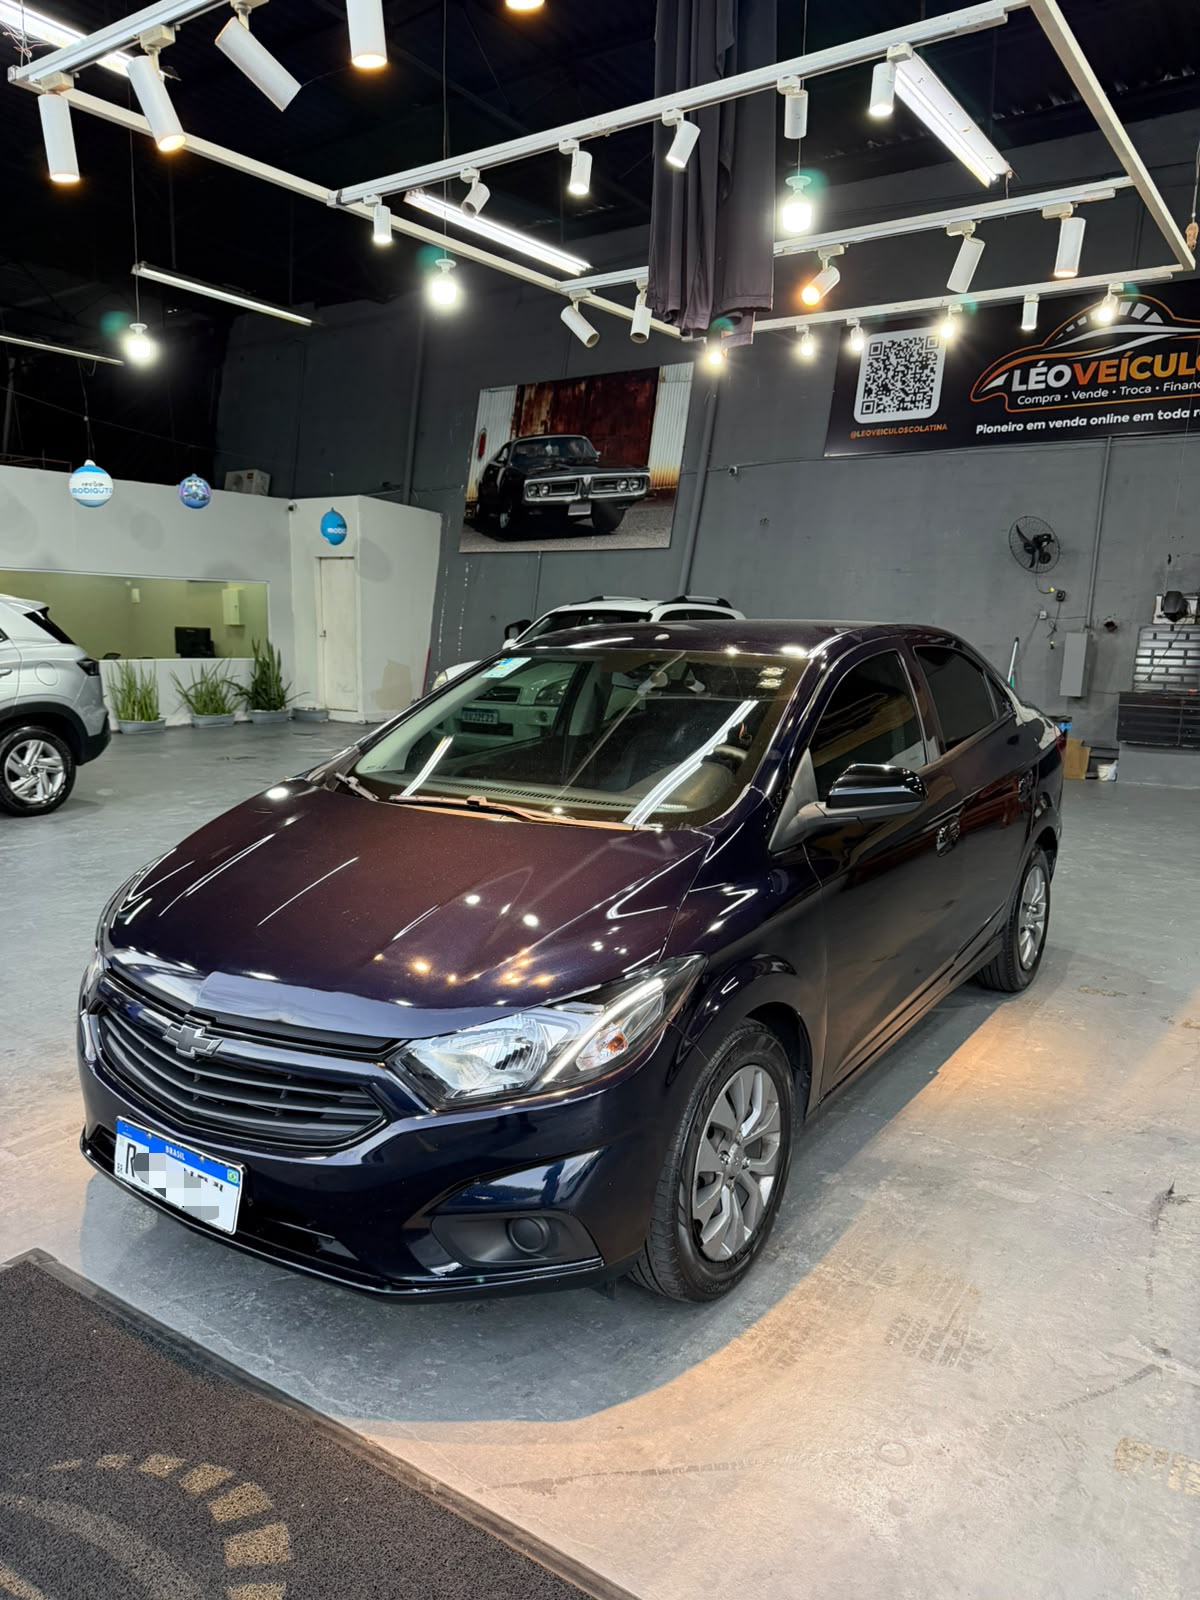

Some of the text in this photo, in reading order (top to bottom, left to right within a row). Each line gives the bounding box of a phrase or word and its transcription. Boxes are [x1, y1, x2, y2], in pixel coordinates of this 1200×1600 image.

[1017, 393, 1061, 406] Compra
[1072, 388, 1109, 400] Vende
[1120, 384, 1151, 396] Troca
[976, 421, 1024, 434] Pioneiro
[1026, 421, 1046, 431] em
[1049, 414, 1087, 428] venda
[1090, 411, 1129, 425] online
[1133, 412, 1153, 422] em
[1157, 408, 1190, 420] toda
[850, 423, 947, 439] @LEOVEICULOSCOLATINA
[165, 1145, 186, 1161] BRASIL
